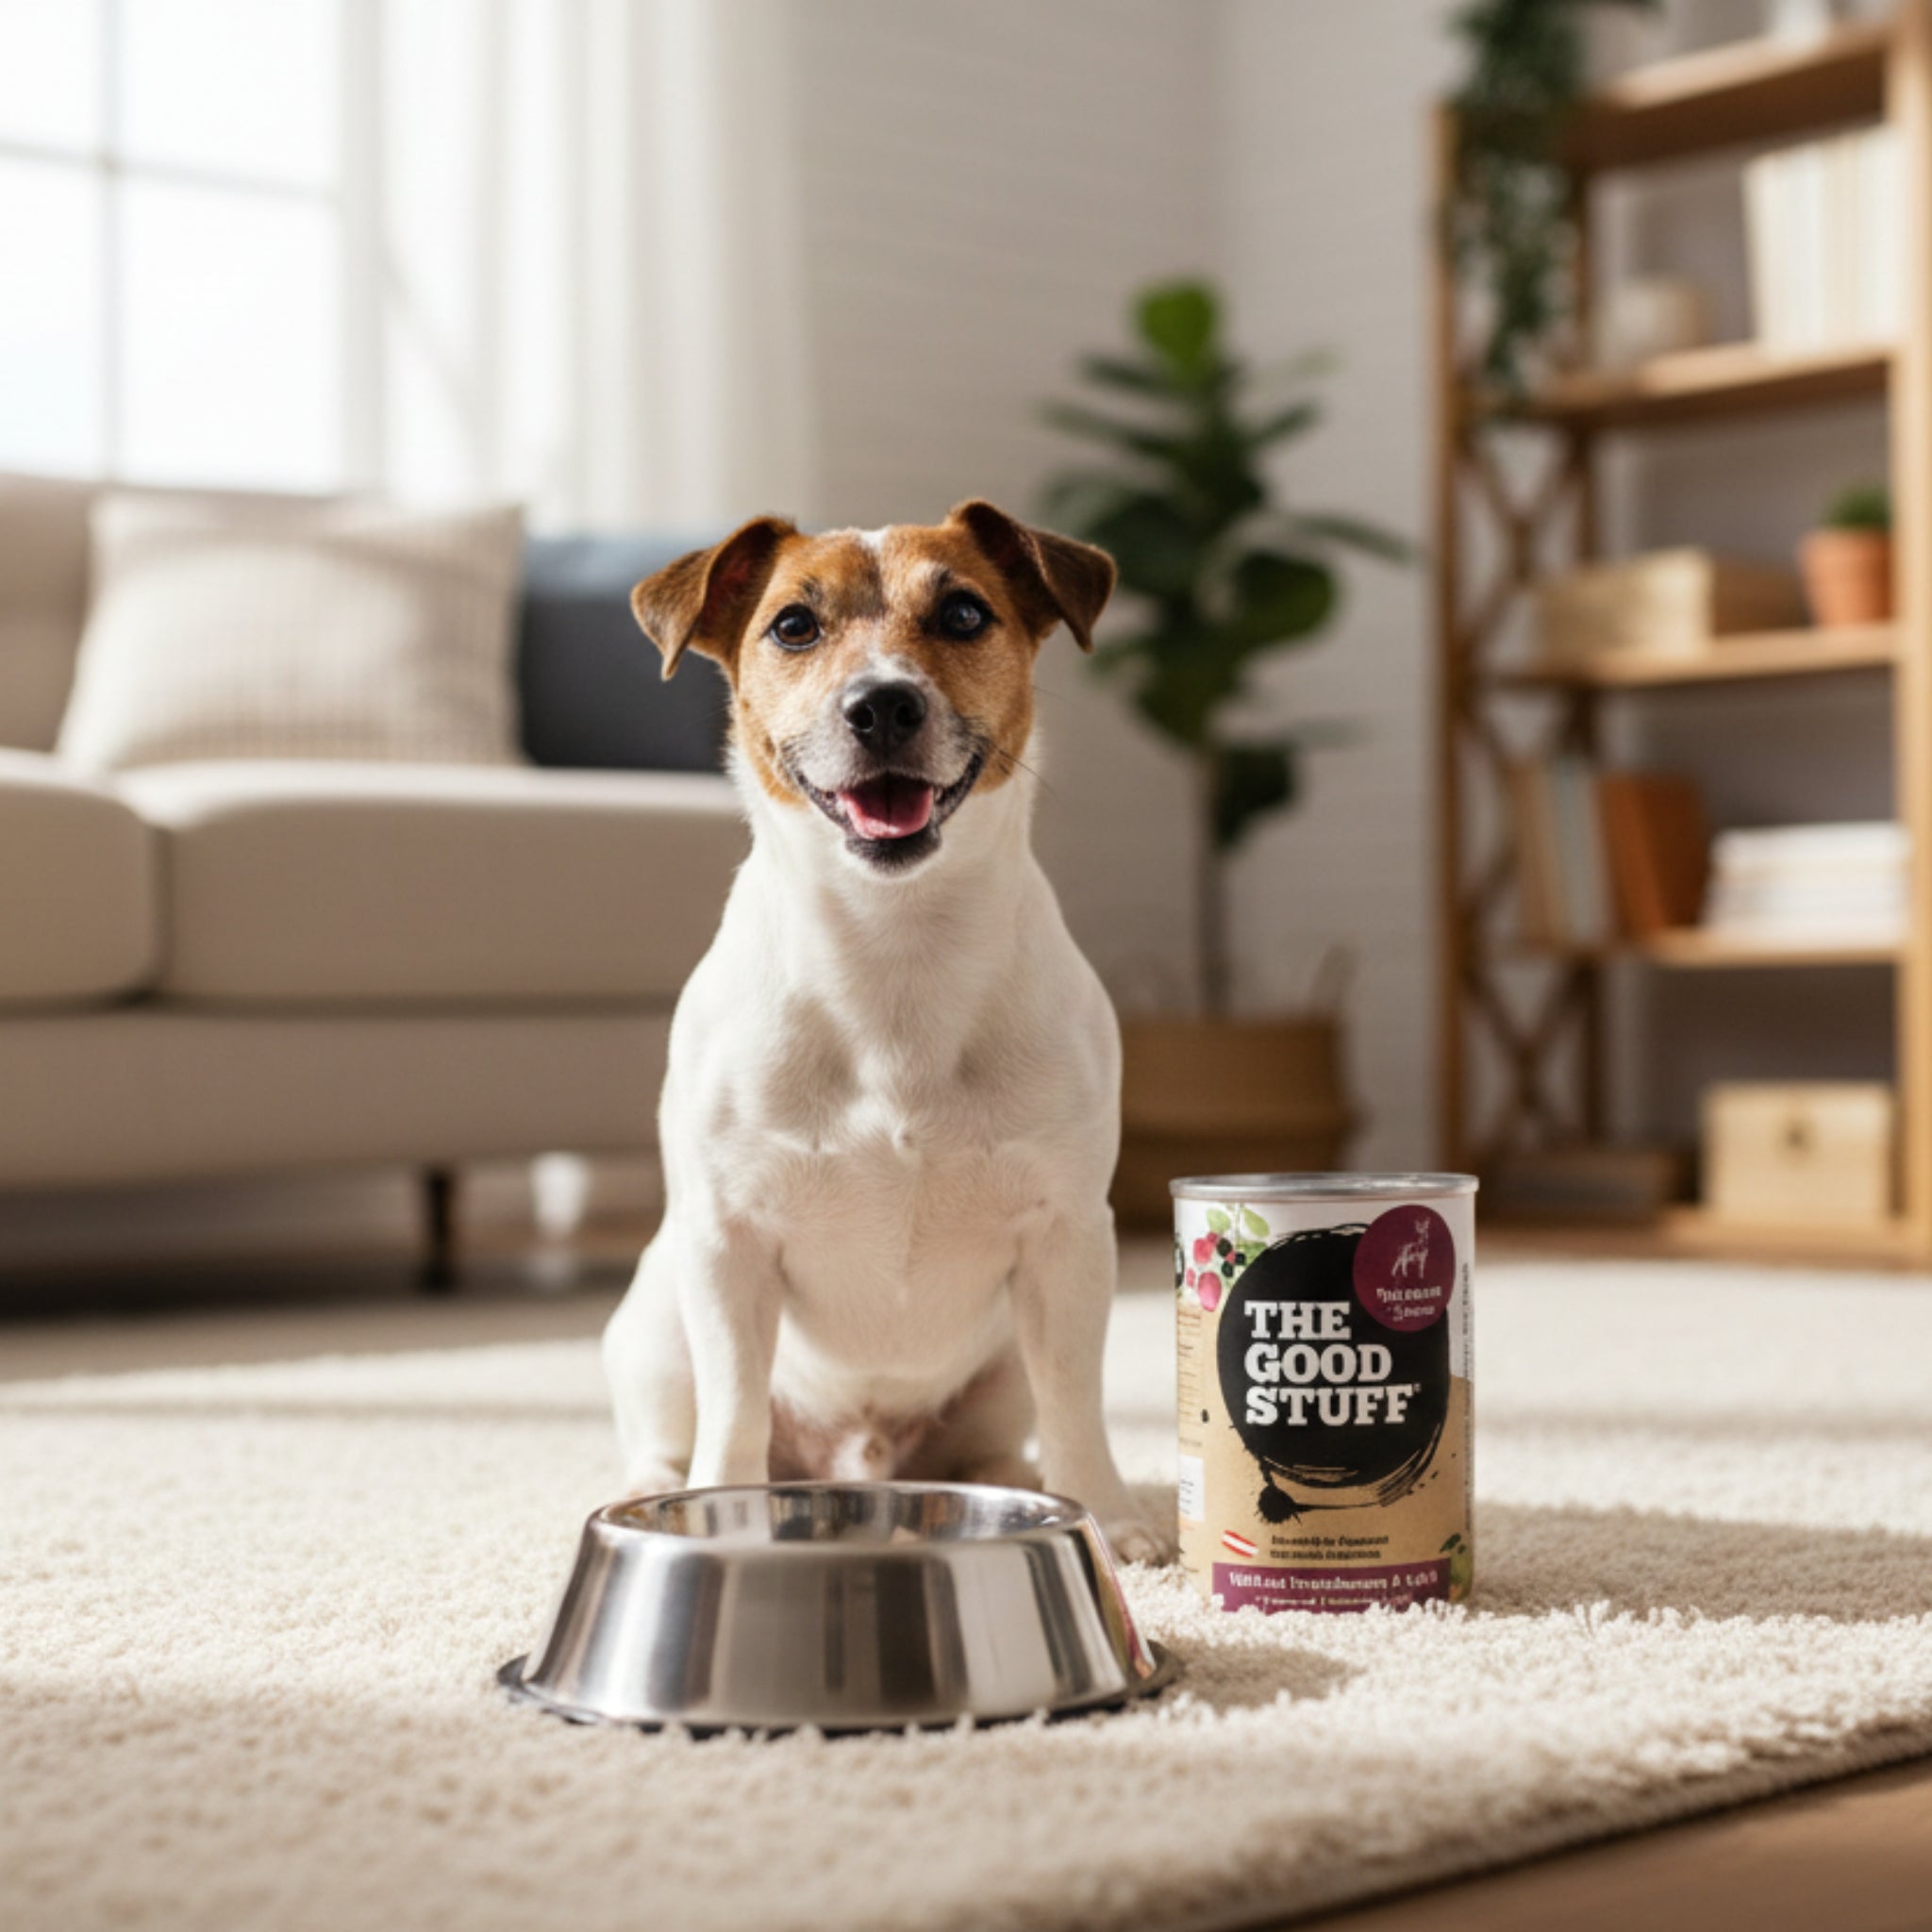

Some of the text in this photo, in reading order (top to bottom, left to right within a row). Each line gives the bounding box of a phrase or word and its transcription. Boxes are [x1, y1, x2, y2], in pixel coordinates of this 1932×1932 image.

[1244, 1300, 1351, 1341] THE
[1244, 1342, 1392, 1384] GOOD
[1245, 1384, 1413, 1426] STUFF
